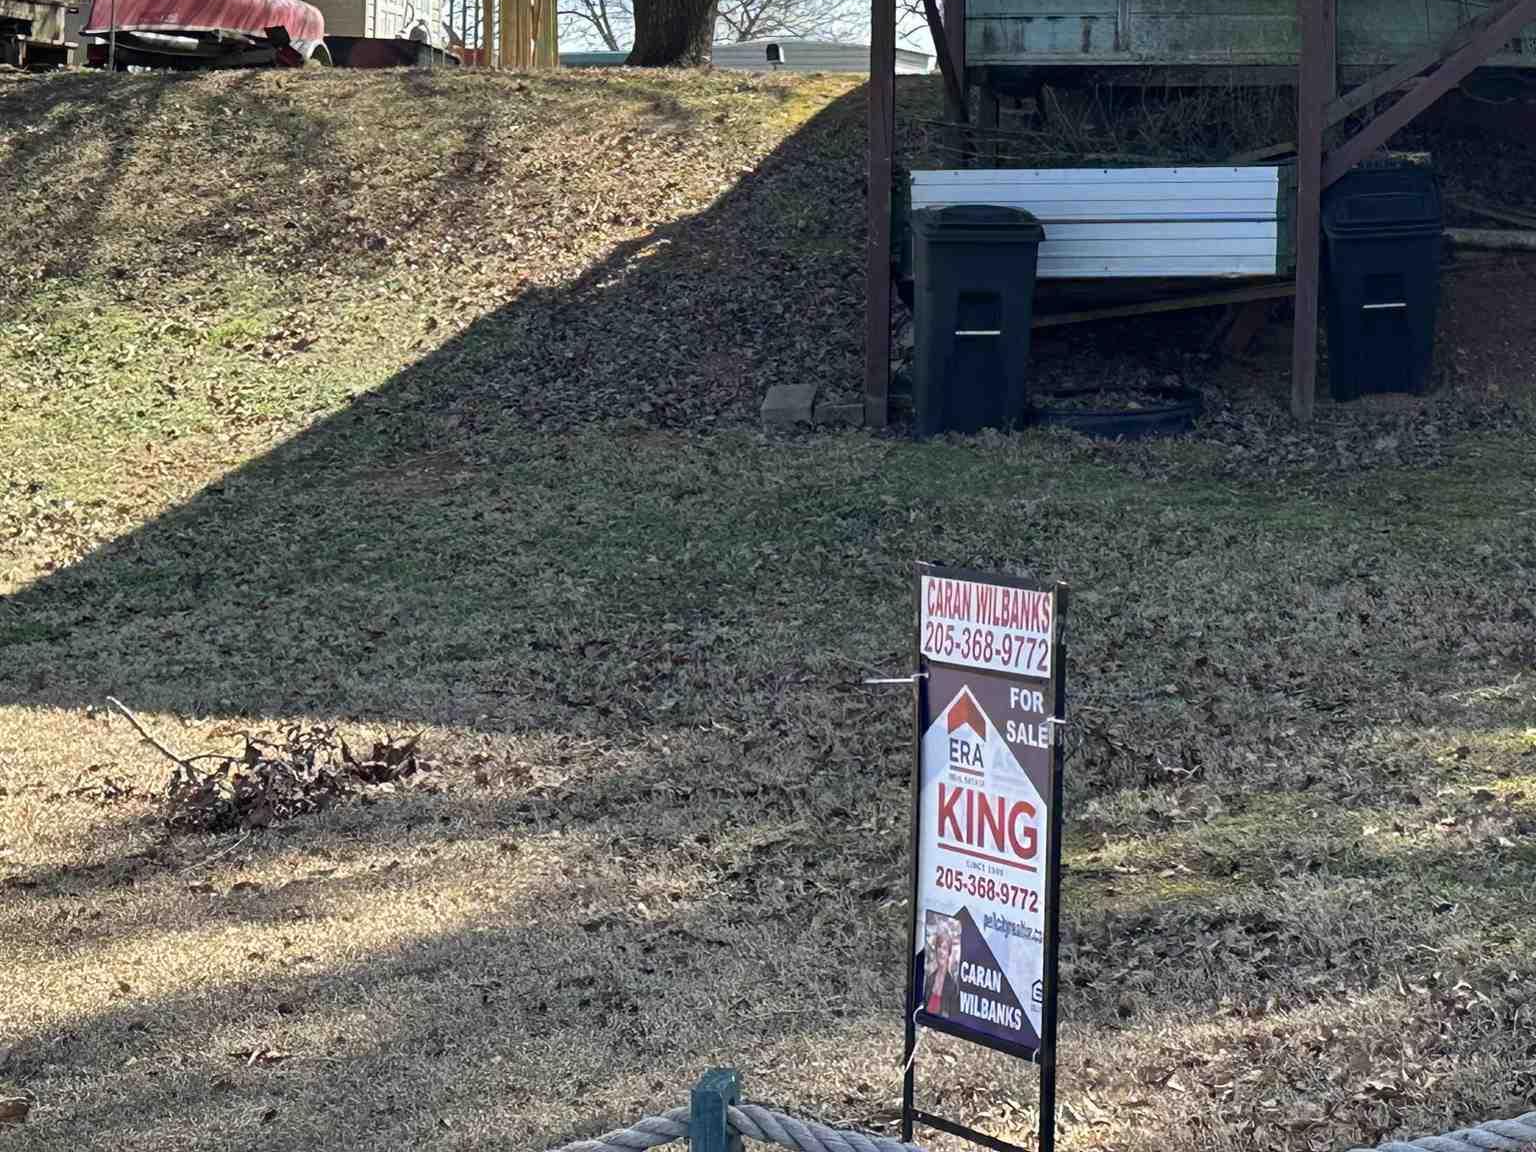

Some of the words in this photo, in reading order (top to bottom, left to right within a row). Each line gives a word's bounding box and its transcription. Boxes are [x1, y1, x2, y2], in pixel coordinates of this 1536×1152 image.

[927, 579, 972, 622] CARAN
[976, 585, 1050, 633] WILBANKS
[925, 621, 1049, 672] 205-368-9772
[1010, 687, 1044, 714] FOR
[950, 738, 985, 768] ERA
[1006, 720, 1049, 749] SALE
[937, 782, 1038, 860] KING
[936, 865, 1039, 913] 205-368-9772
[961, 961, 1002, 993] CARAN
[959, 990, 1022, 1030] WILBANKS
